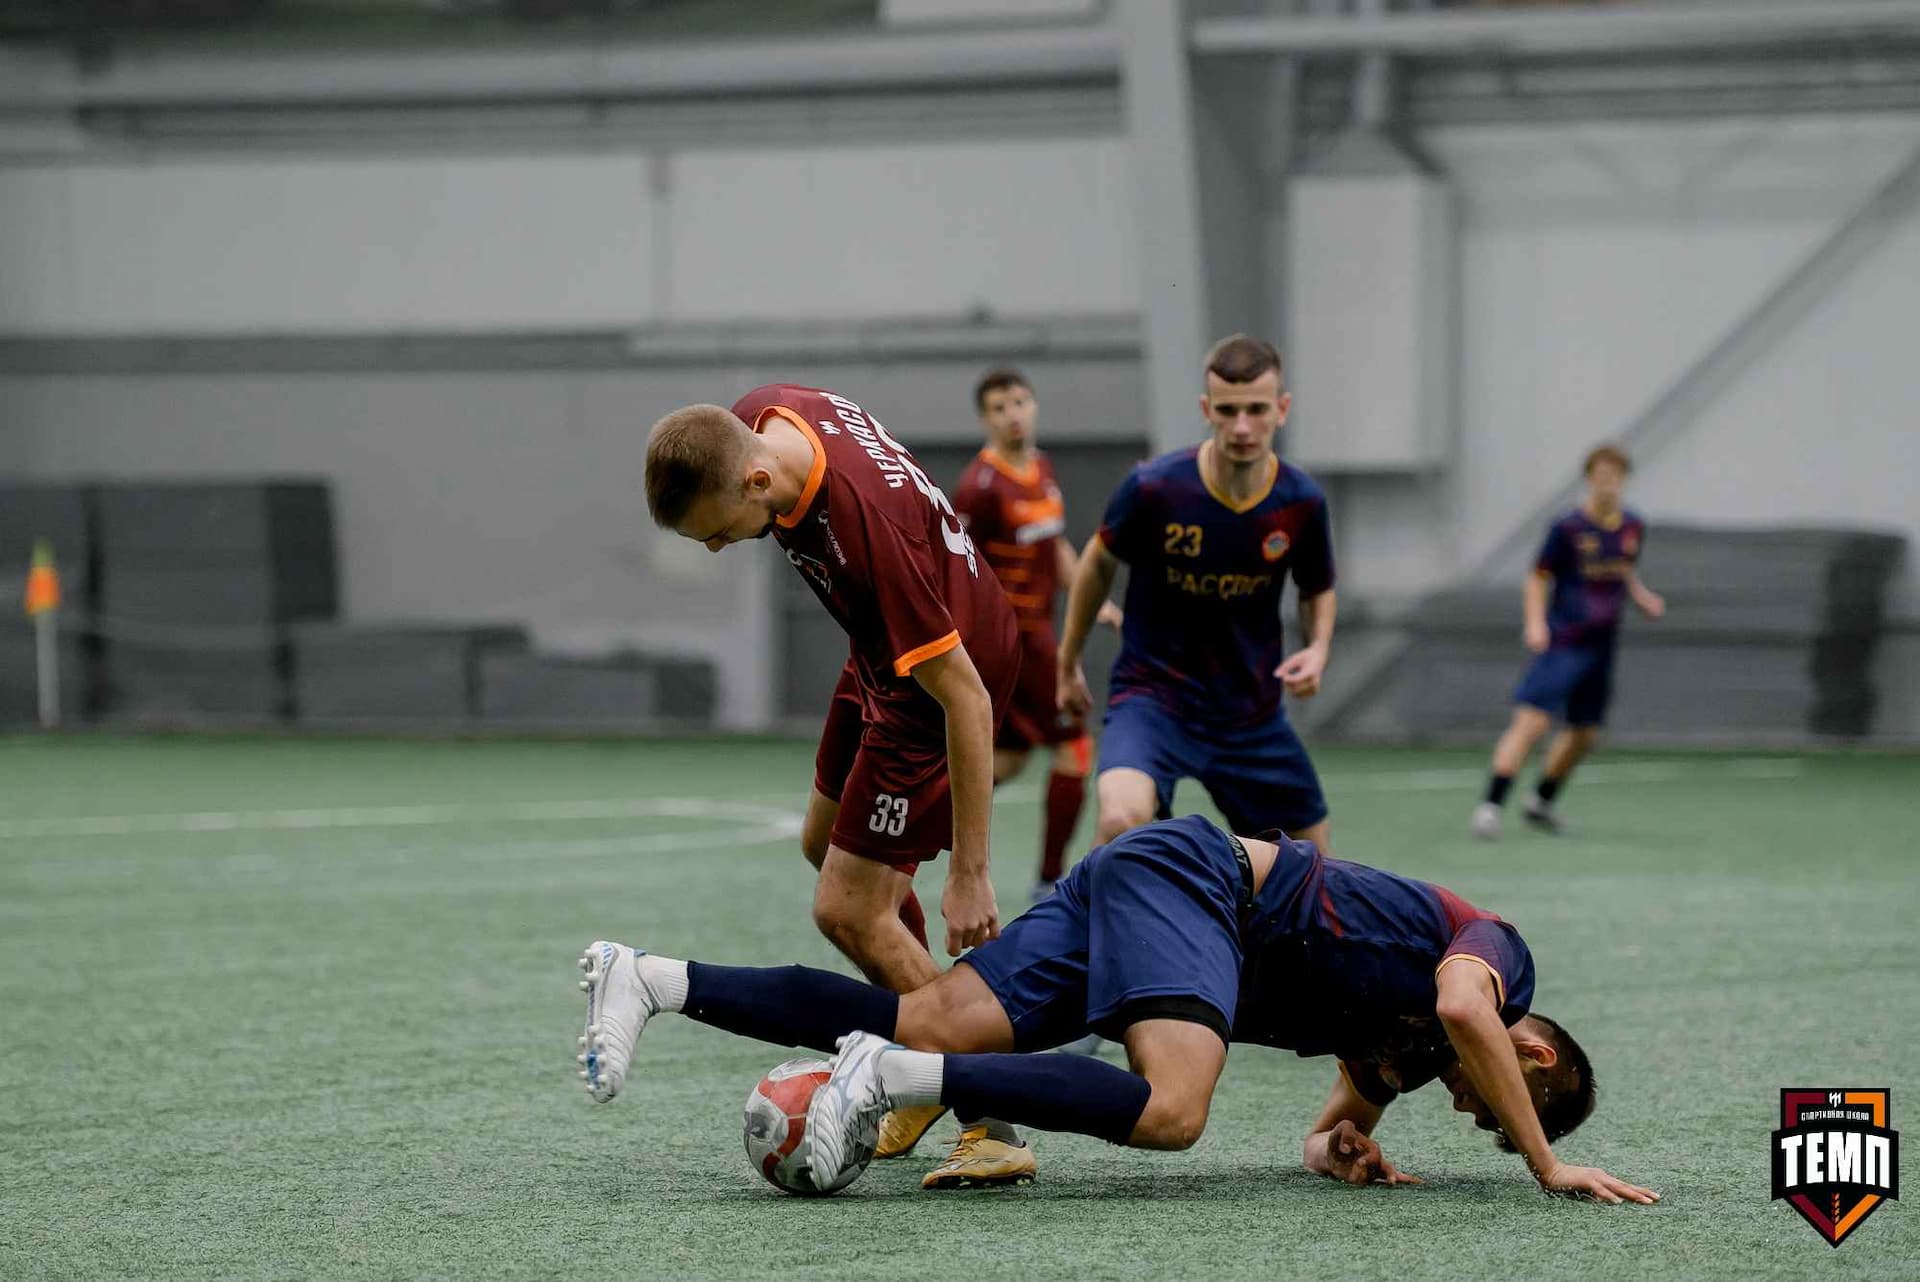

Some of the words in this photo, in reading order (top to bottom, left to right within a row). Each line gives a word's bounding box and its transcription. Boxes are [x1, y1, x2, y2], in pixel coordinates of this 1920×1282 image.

[819, 392, 909, 488] ЧЕРКАСО
[1164, 523, 1203, 557] 23
[869, 793, 909, 836] 33
